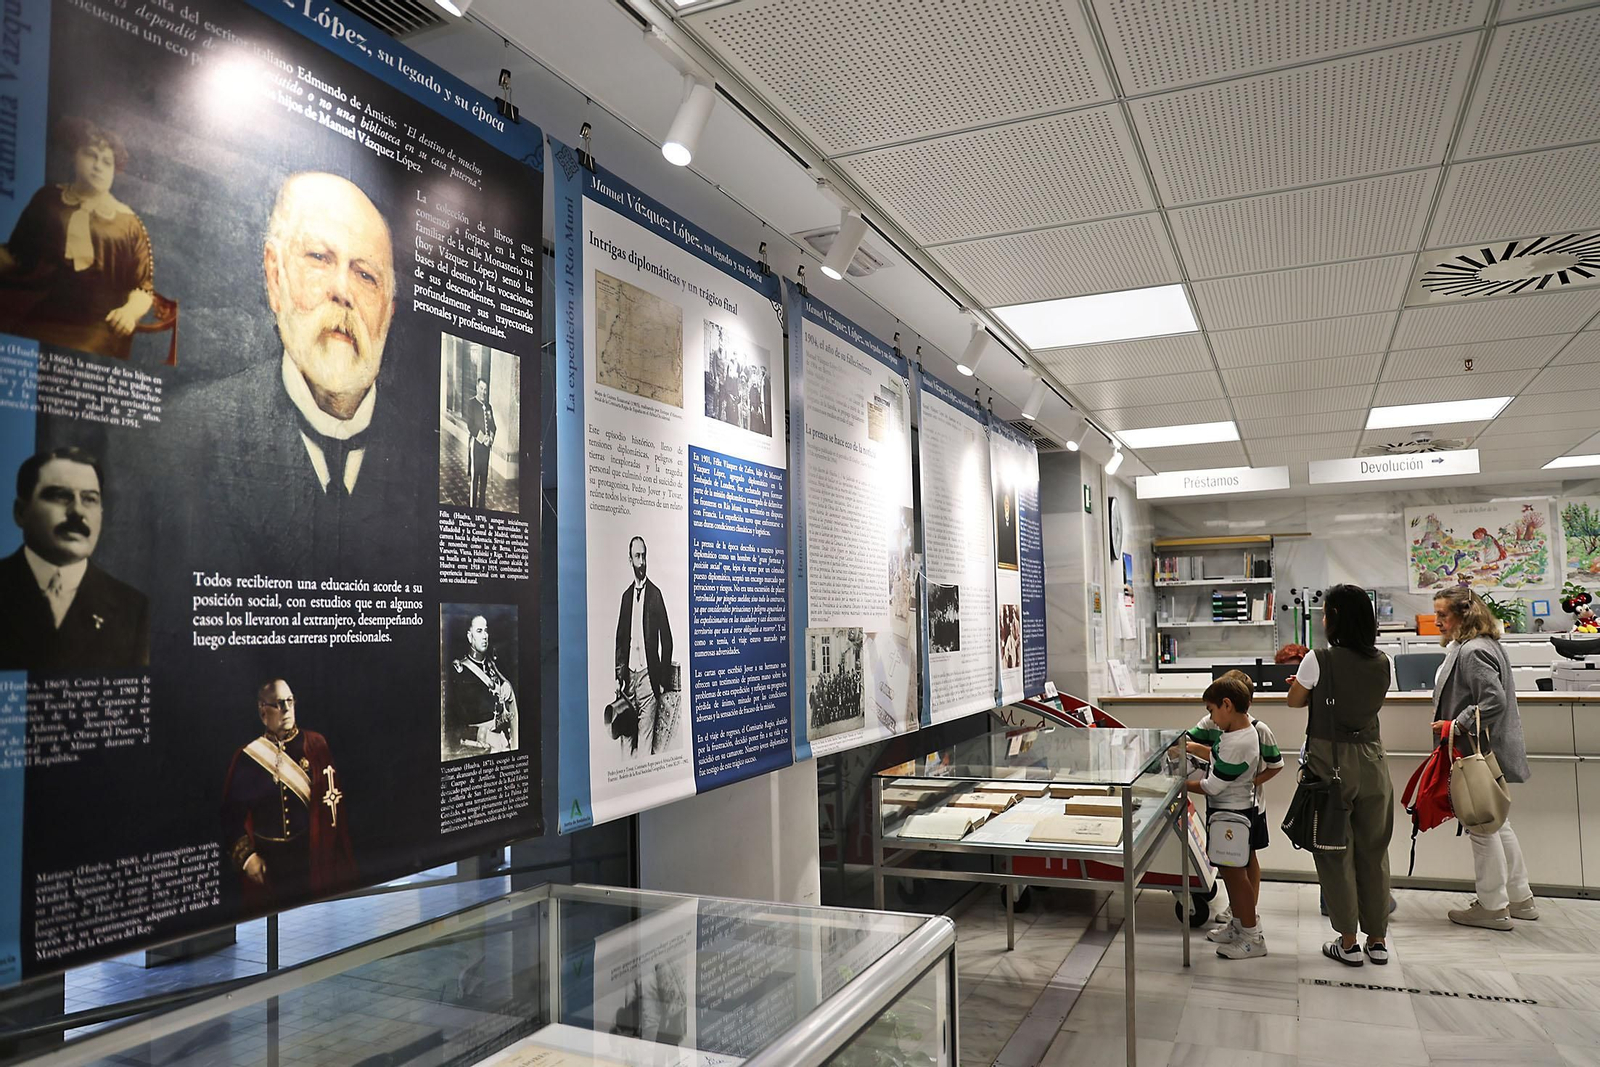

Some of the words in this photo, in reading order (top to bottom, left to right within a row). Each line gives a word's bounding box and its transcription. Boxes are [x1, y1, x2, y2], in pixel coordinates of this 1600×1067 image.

[135, 4, 196, 41] dependió
[203, 37, 217, 51] de
[307, 91, 315, 103] o
[319, 97, 332, 111] no
[336, 106, 356, 124] una
[360, 117, 400, 146] biblioteca
[404, 142, 415, 154] en
[418, 148, 428, 161] su
[431, 154, 447, 171] casa
[302, 0, 373, 57] López,
[377, 46, 394, 66] su
[398, 57, 441, 94] legado
[443, 86, 452, 102] y
[454, 93, 468, 111] su
[471, 101, 505, 133] época
[143, 29, 162, 46] un
[165, 40, 188, 58] eco
[277, 91, 303, 115] hijos
[305, 105, 318, 121] de
[318, 109, 356, 140] Manuel
[356, 129, 395, 159] Vázquez
[396, 149, 423, 174] López.
[180, 6, 199, 25] del
[204, 21, 250, 49] escritor
[253, 42, 293, 74] italiano
[297, 66, 347, 102] Edmundo
[350, 94, 361, 111] de
[364, 103, 397, 129] Amicis:
[418, 132, 445, 156] destino
[446, 147, 457, 162] de
[458, 153, 483, 176] muchos
[416, 190, 426, 203] La
[436, 202, 469, 225] colección
[477, 221, 485, 232] de
[494, 228, 513, 245] libros
[521, 243, 533, 254] que
[416, 208, 450, 229] comenzó
[465, 229, 490, 249] forjarse
[495, 246, 503, 255] en
[509, 249, 515, 260] la
[520, 255, 533, 267] casa
[565, 196, 575, 242] Muni
[590, 176, 624, 205] Manuel
[626, 192, 671, 231] Vázquez
[672, 220, 703, 250] López,
[704, 242, 712, 252] su
[712, 246, 733, 266] legado
[732, 259, 738, 271] y
[738, 263, 746, 274] su
[746, 264, 762, 284] época
[415, 236, 433, 253] (hoy
[439, 245, 468, 268] Vázquez
[473, 261, 498, 281] López)
[503, 274, 521, 288] sentó
[525, 281, 533, 294] las
[416, 221, 445, 242] familiar
[447, 236, 456, 247] de
[458, 240, 464, 251] la
[467, 246, 482, 260] calle
[484, 252, 523, 277] Monasterio
[526, 269, 533, 280] 11
[565, 246, 575, 275] Río
[589, 230, 626, 260] Intrigas
[628, 249, 680, 286] diplomáticas
[681, 279, 687, 292] y
[688, 281, 698, 293] un
[699, 283, 722, 307] trágico
[723, 297, 738, 315] final
[415, 250, 434, 268] bases
[437, 260, 448, 274] del
[451, 267, 476, 286] destino
[479, 280, 483, 290] y
[486, 280, 495, 293] las
[498, 288, 533, 308] vocaciones
[415, 266, 424, 279] de
[429, 274, 441, 286] sus
[446, 280, 495, 308] descendientes,
[501, 302, 533, 320] marcando
[568, 279, 575, 296] al
[414, 283, 471, 312] profundamente
[477, 308, 489, 319] sus
[495, 313, 533, 334] trayectorias
[414, 299, 452, 320] personales
[452, 314, 458, 325] y
[459, 316, 506, 338] profesionales.
[565, 301, 577, 387] expedición
[820, 340, 824, 350] el
[825, 343, 834, 355] año
[835, 347, 840, 358] de
[846, 353, 872, 376] fallecimiento
[566, 392, 575, 414] La
[589, 424, 599, 435] Este
[606, 431, 626, 441] episodio
[632, 435, 655, 449] histórico,
[661, 442, 672, 452] lleno
[678, 446, 682, 454] de
[806, 423, 811, 435] La
[812, 428, 828, 440] prensa
[828, 435, 834, 443] se
[834, 434, 844, 447] hace
[853, 441, 858, 451] de
[859, 442, 863, 454] la
[1183, 475, 1239, 489] Préstamos
[1360, 457, 1424, 475] Devolución
[193, 571, 231, 587] Todos
[236, 575, 293, 589] recibieron
[297, 579, 317, 590] una
[321, 577, 370, 592] educación
[373, 580, 402, 593] acorde
[405, 585, 410, 593] a
[413, 584, 423, 594] su
[193, 593, 242, 611] posición
[247, 594, 282, 609] social,
[287, 599, 306, 609] con
[311, 596, 351, 609] estudios
[355, 599, 372, 613] que
[375, 599, 386, 609] en
[390, 598, 423, 613] algunos
[193, 615, 223, 626] casos
[227, 612, 242, 626] los
[245, 612, 289, 626] llevaron
[292, 612, 300, 626] al
[303, 614, 355, 629] extranjero,
[358, 613, 423, 629] desempeñando
[193, 631, 225, 650] luego
[228, 631, 285, 645] destacadas
[288, 632, 327, 644] carreras
[330, 630, 392, 647] profesionales.
[1429, 989, 1459, 999] su
[1467, 993, 1538, 1006] turno
